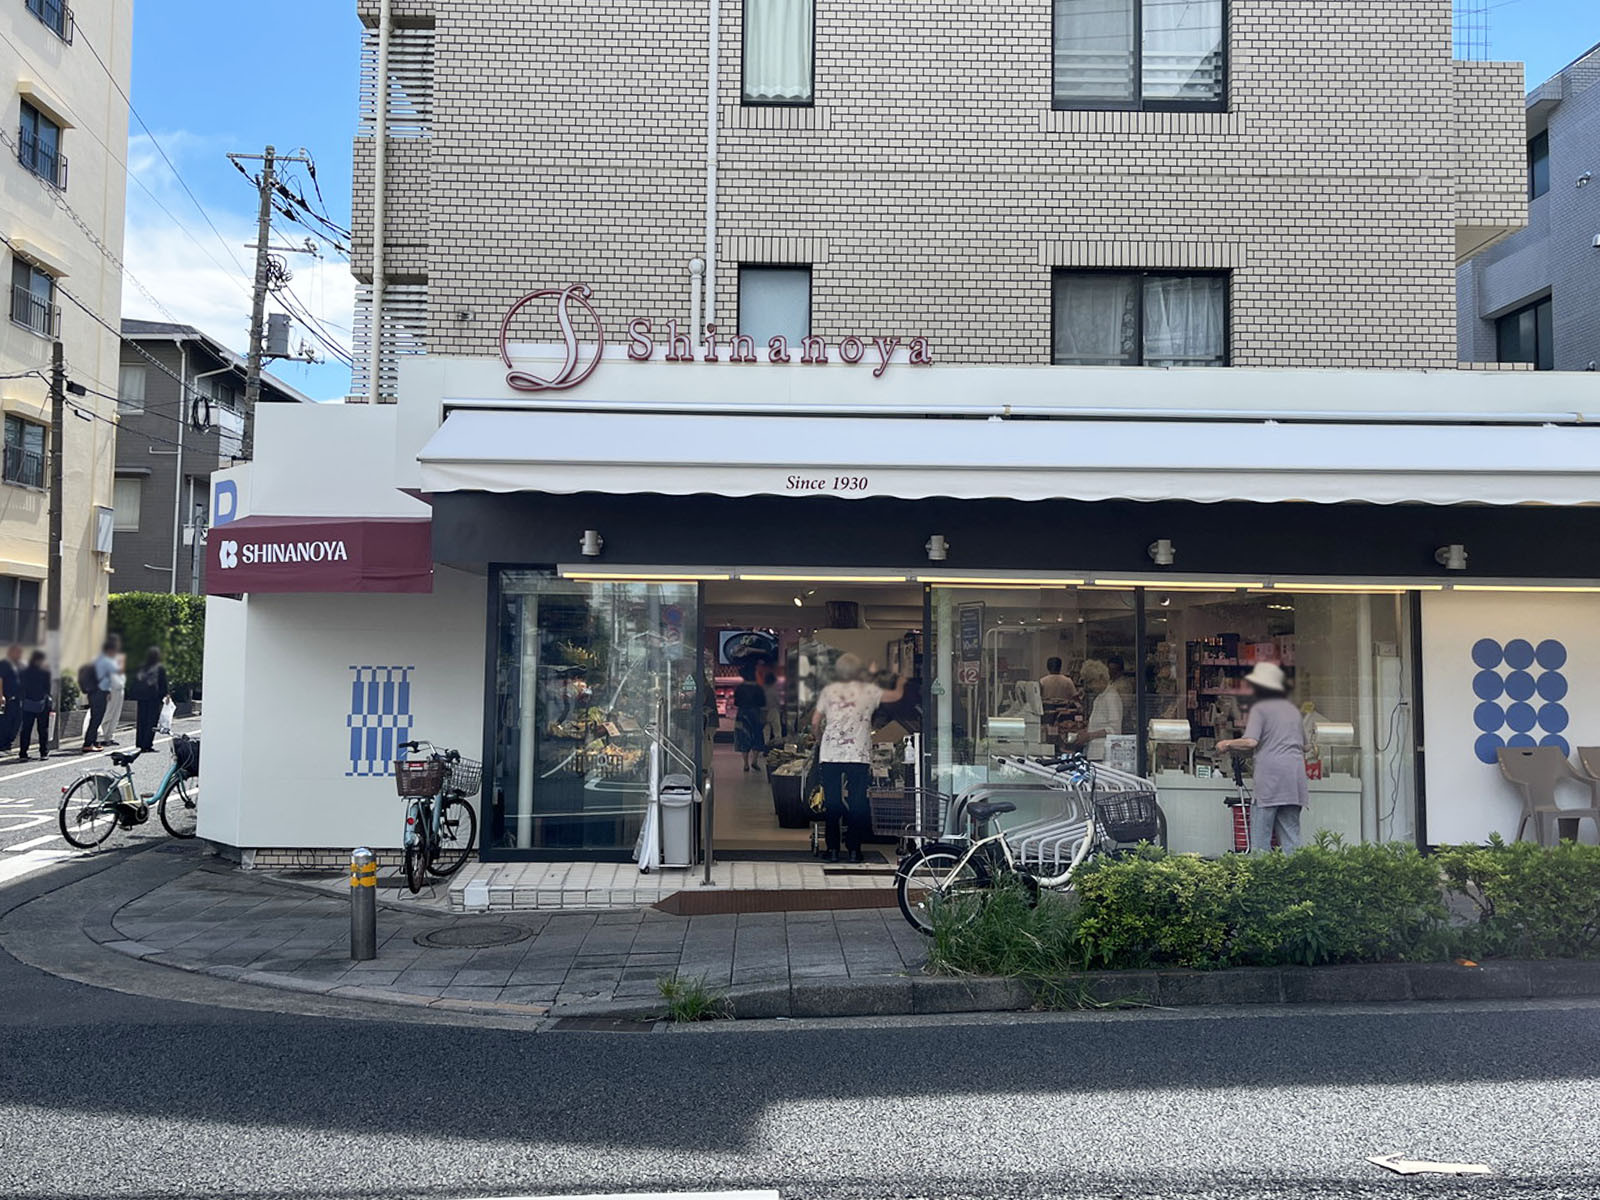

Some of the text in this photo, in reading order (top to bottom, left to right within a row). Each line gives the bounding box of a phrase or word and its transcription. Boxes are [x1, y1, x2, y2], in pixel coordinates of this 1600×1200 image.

[627, 318, 932, 378] Shinanoya
[786, 475, 868, 490] Since 1930
[242, 540, 348, 564] SHINANOYA
